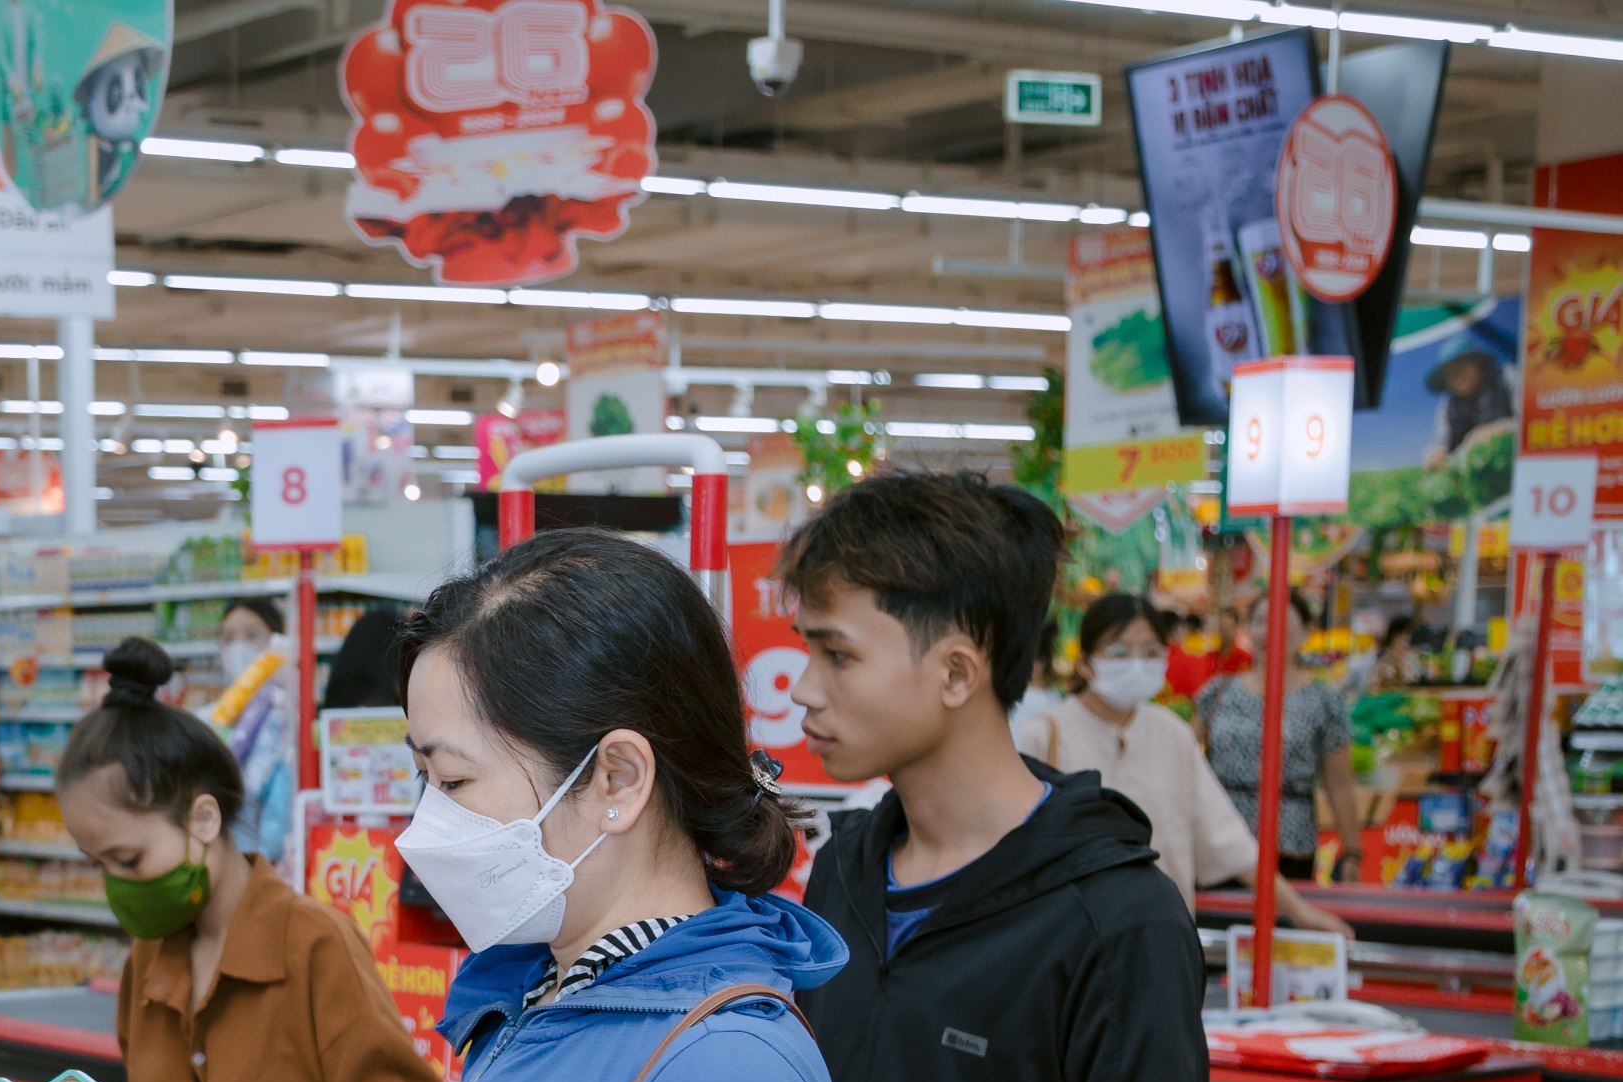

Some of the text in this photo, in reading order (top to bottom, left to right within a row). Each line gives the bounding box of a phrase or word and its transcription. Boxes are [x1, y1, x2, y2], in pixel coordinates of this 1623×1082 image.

[410, 6, 584, 106] 26
[1296, 128, 1384, 240] 26
[1247, 417, 1262, 462] 9
[1305, 415, 1326, 459] 9
[282, 465, 307, 504] 8
[1530, 486, 1576, 517] 10
[325, 857, 380, 913] GIÁ
[403, 961, 445, 995] HƠN
